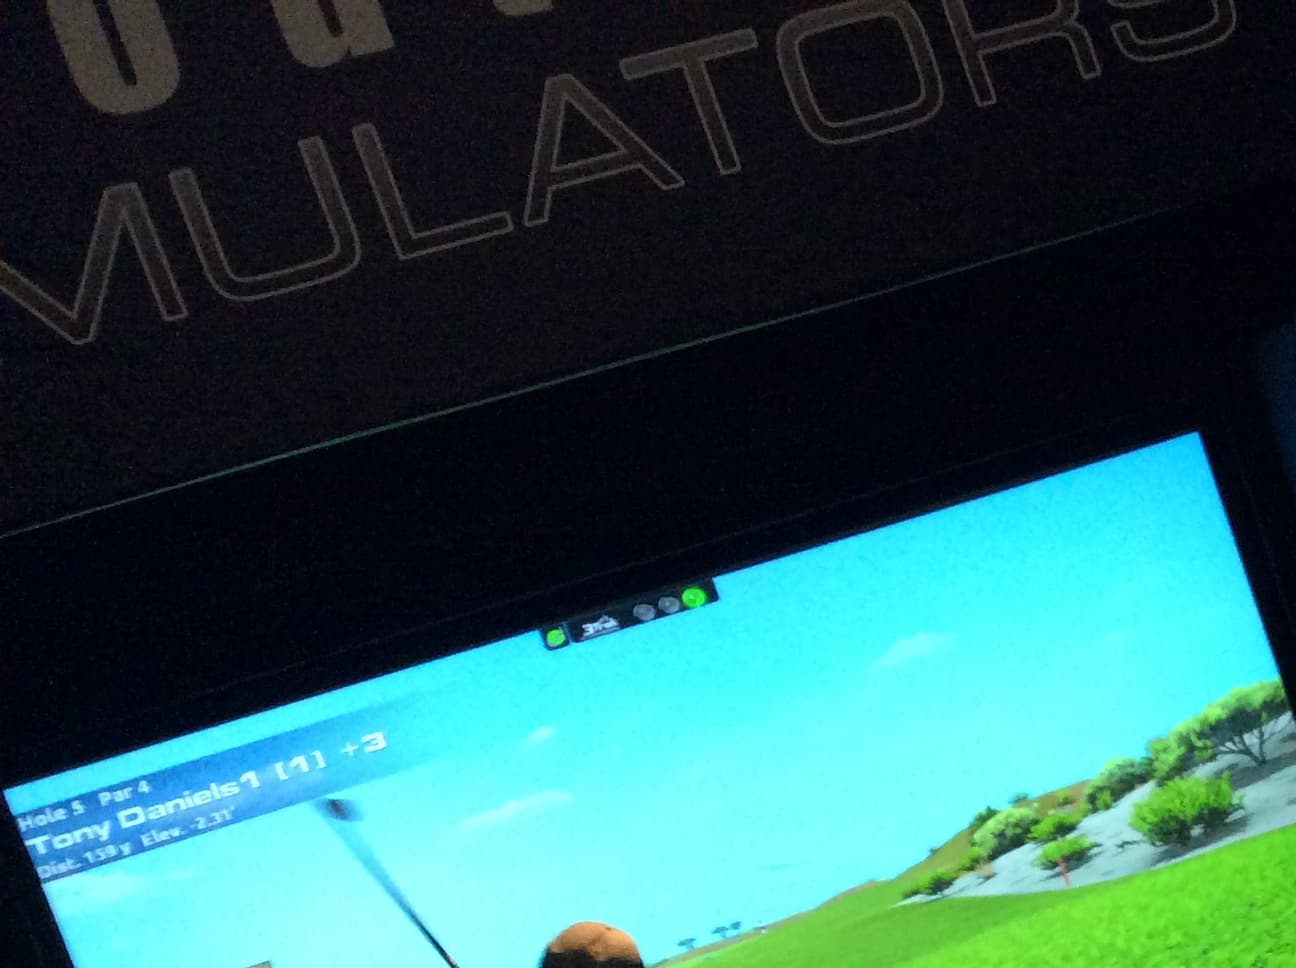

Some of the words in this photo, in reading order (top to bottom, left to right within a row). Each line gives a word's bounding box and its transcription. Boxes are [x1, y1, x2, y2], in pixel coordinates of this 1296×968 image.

[17, 806, 69, 833] Hole
[71, 799, 87, 816] 5
[98, 786, 133, 807] Par
[138, 780, 151, 794] 4
[24, 820, 112, 854] Tony
[117, 770, 261, 829] Daniels1
[341, 731, 388, 758] +3
[37, 857, 82, 879] Dist.
